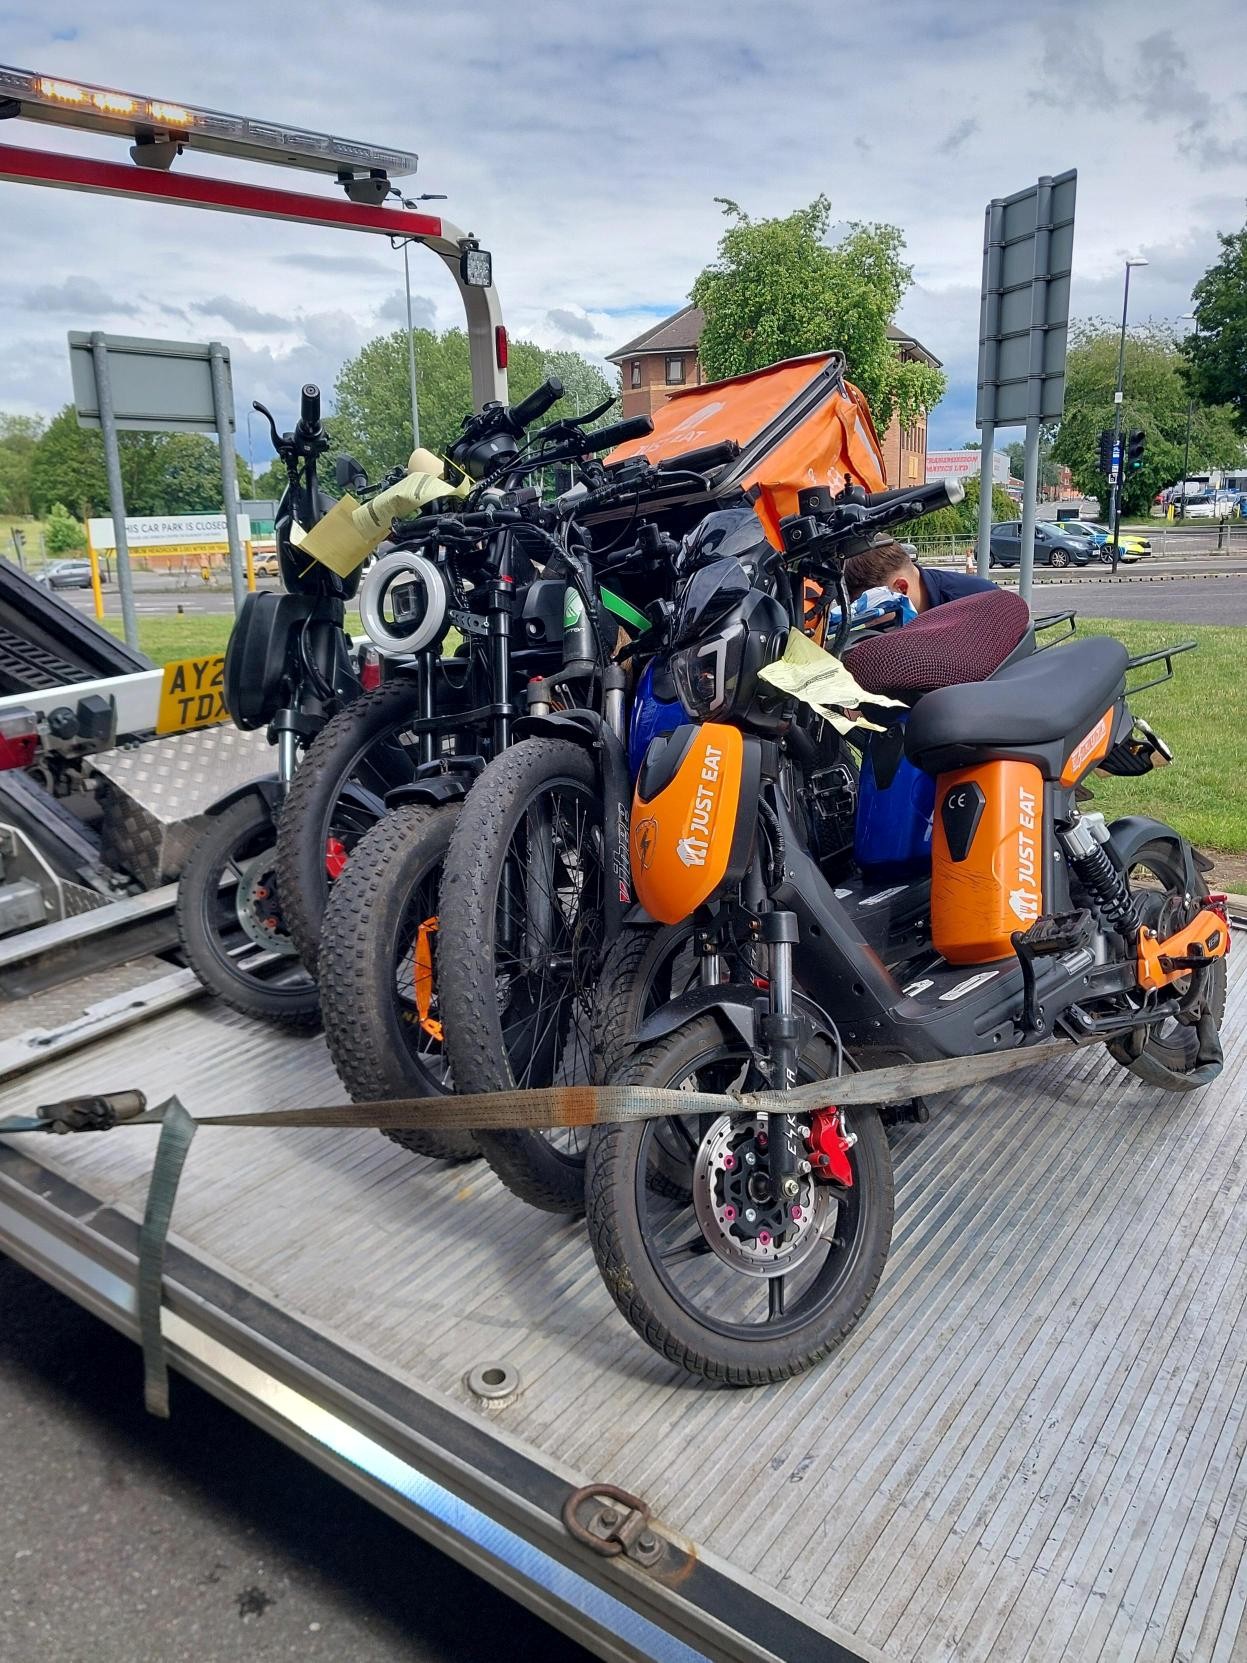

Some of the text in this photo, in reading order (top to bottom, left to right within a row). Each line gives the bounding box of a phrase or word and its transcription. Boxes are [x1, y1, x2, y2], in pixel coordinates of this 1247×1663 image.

[125, 521, 228, 534] HIS CAR PARK IS CLOSED
[169, 657, 225, 695] AY2
[177, 690, 230, 725] TDX
[690, 744, 723, 835] JUST EAT
[948, 792, 966, 809] CE
[1018, 786, 1037, 887] JUST EAT
